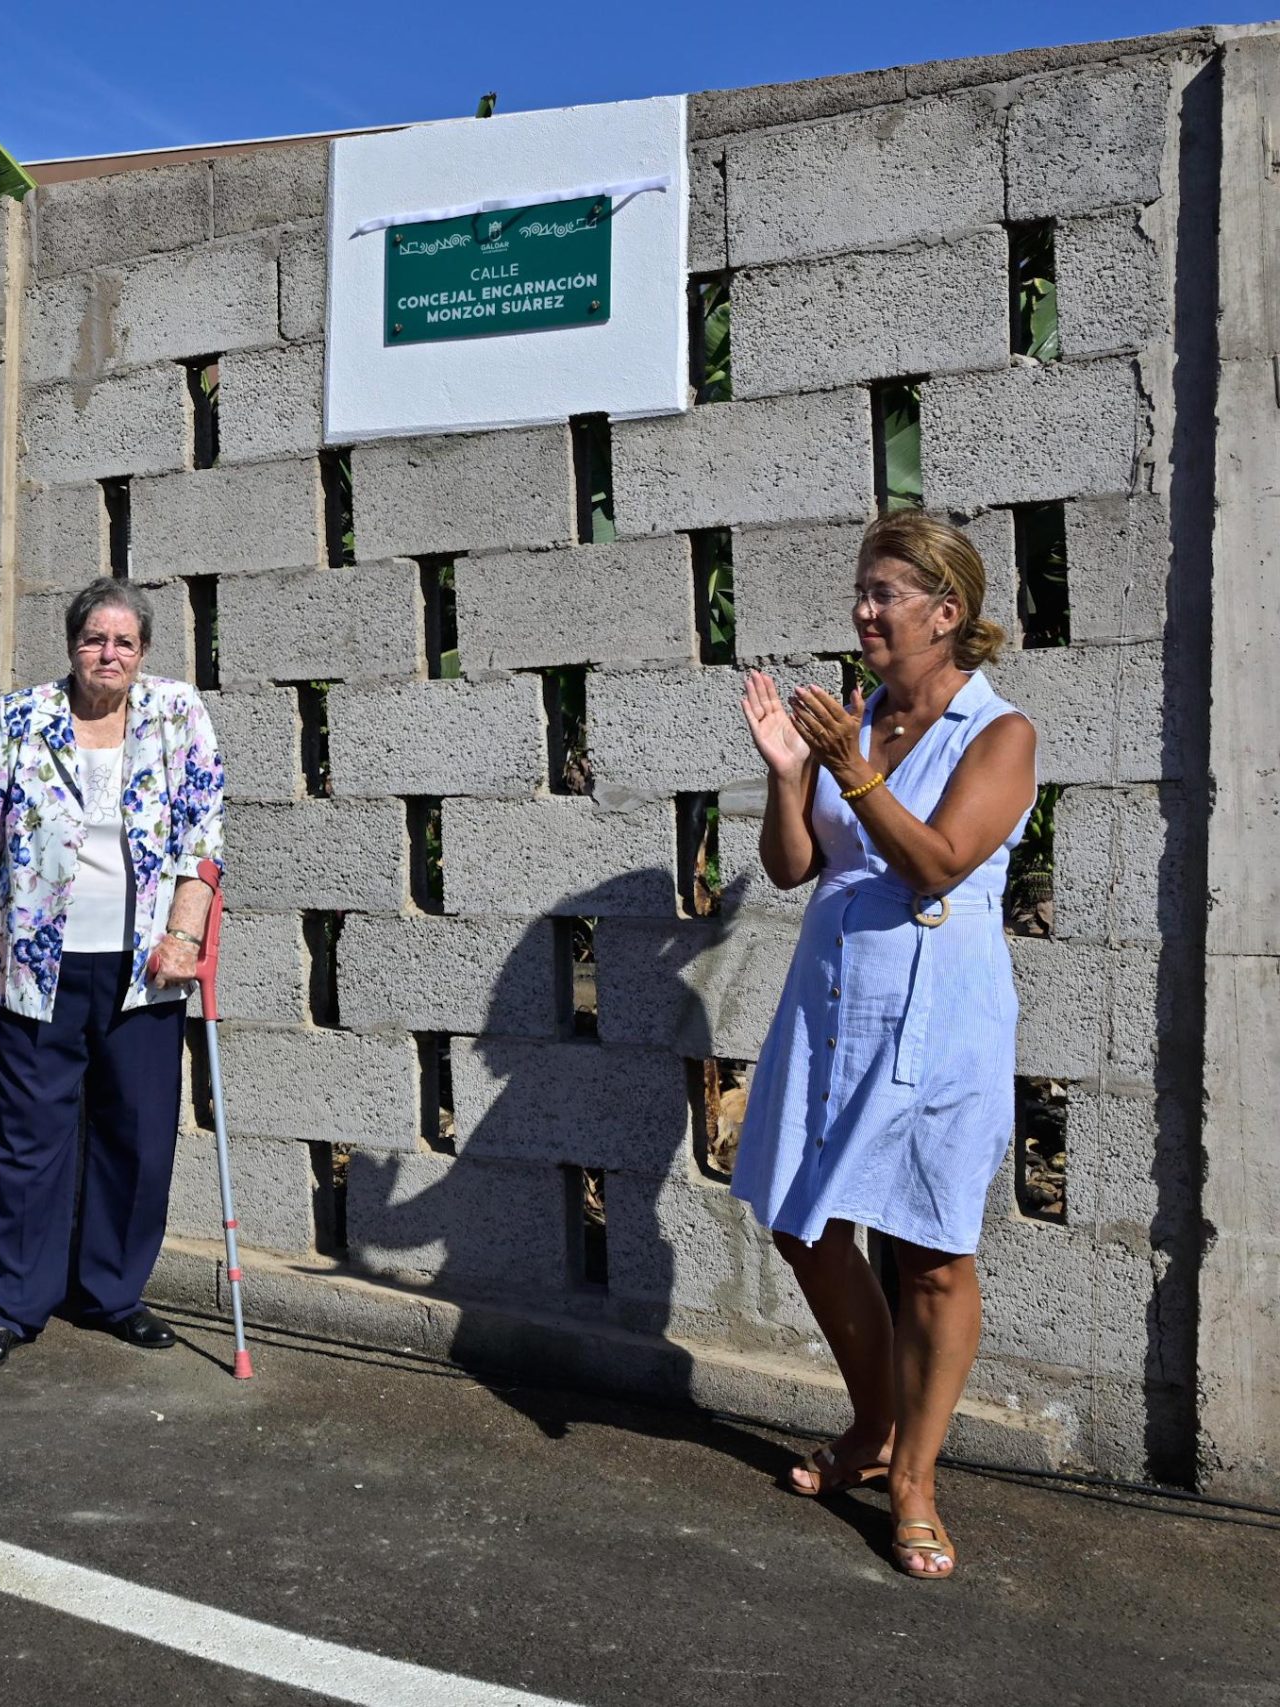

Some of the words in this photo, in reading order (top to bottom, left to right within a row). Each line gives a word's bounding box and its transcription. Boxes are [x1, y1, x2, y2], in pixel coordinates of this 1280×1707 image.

[470, 263, 520, 281] CALLE
[398, 289, 476, 310] CONCEJAL
[482, 272, 598, 300] ENCARNACIÓN
[427, 300, 496, 324] MONZÓN
[501, 294, 565, 315] SUÁREZ
